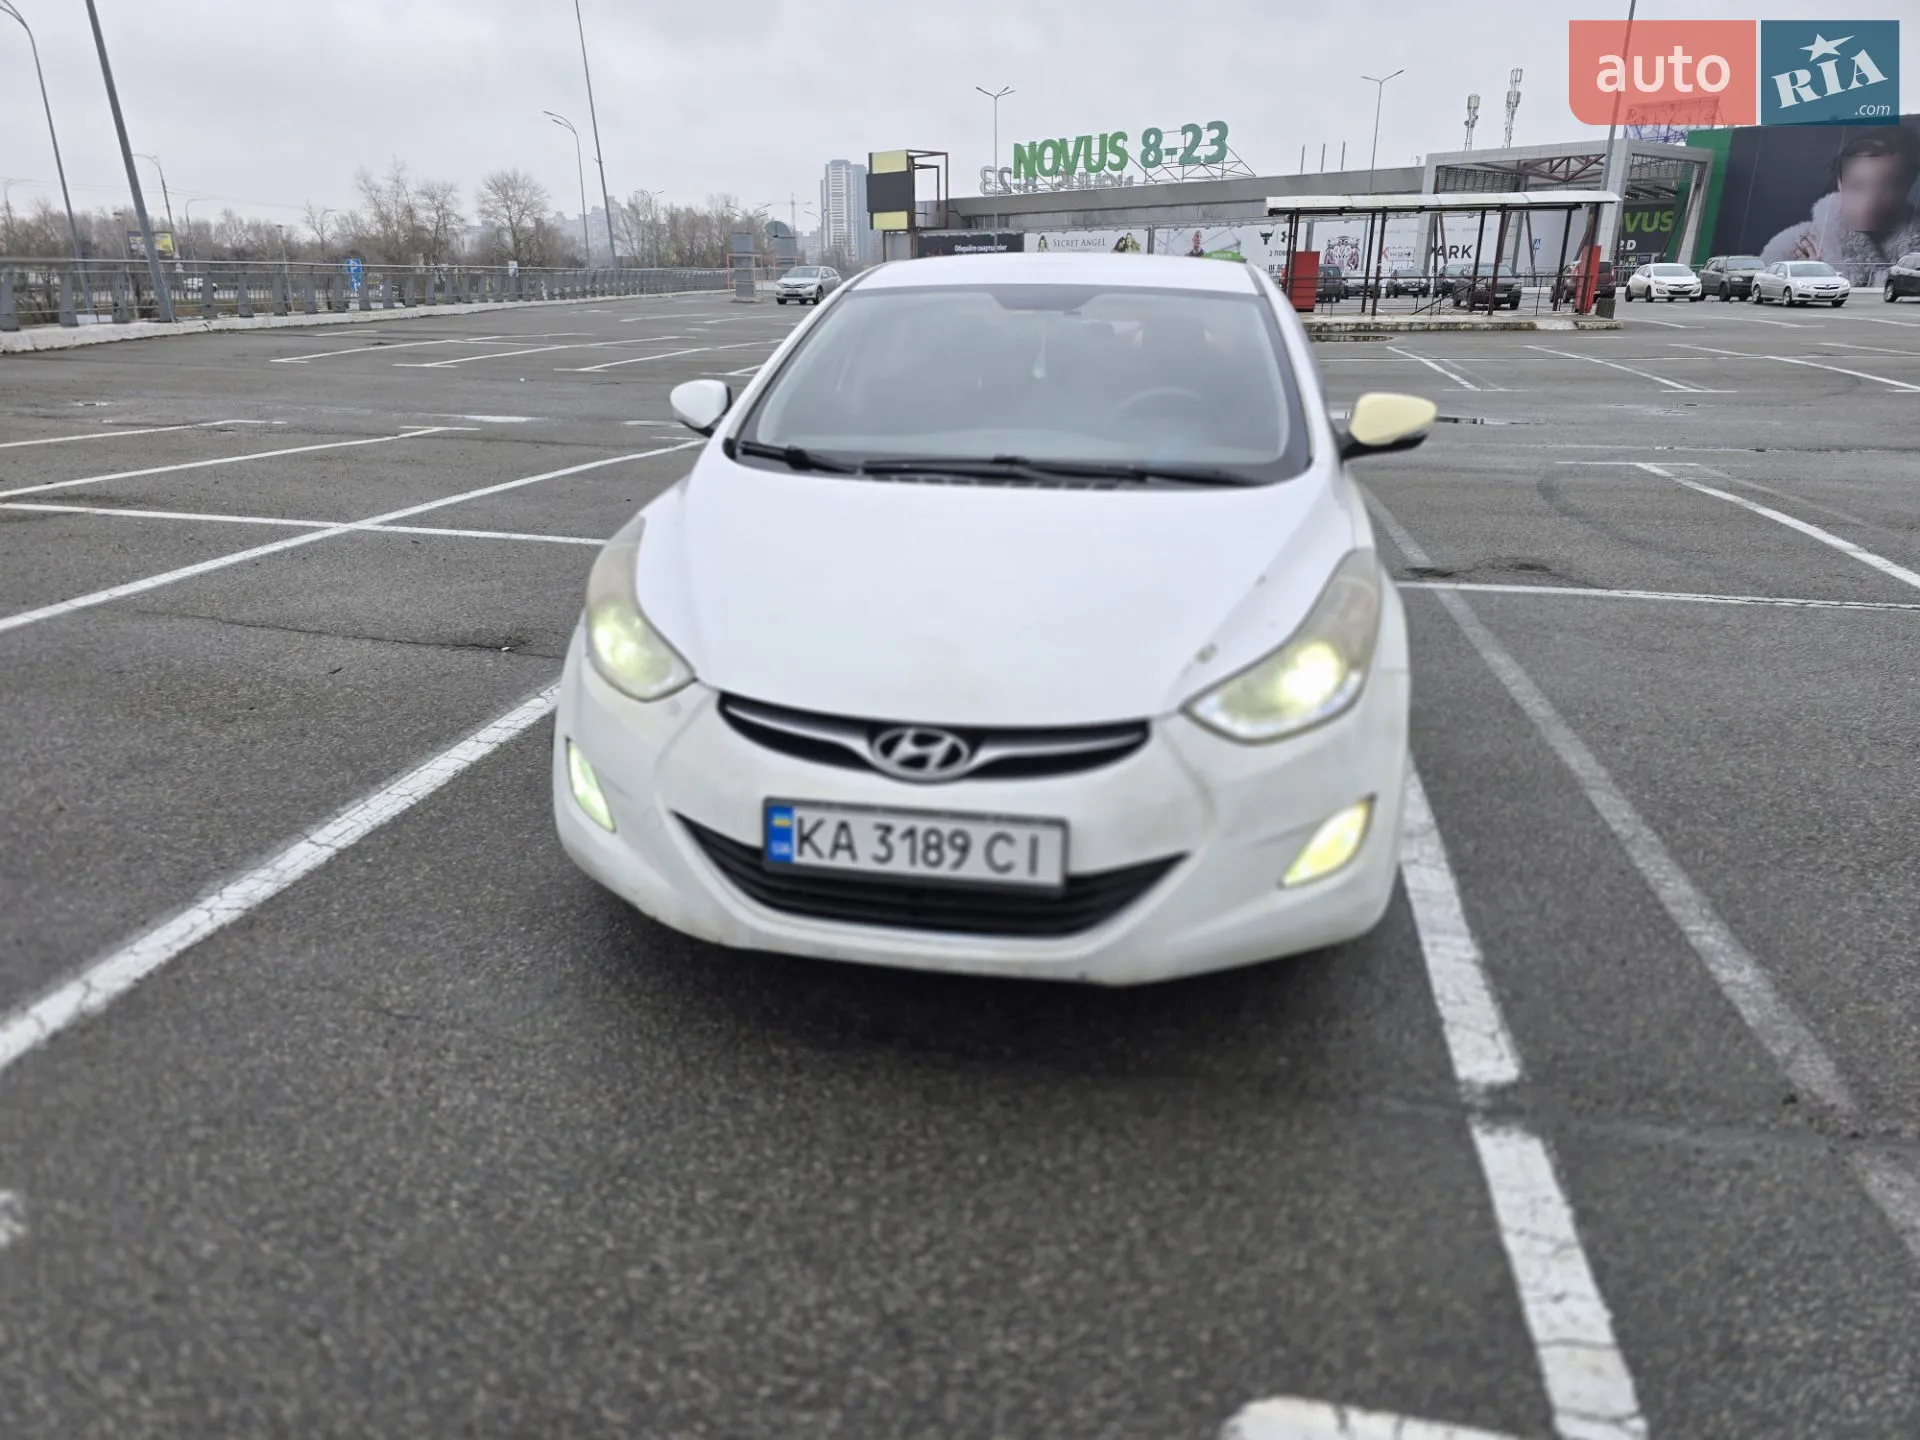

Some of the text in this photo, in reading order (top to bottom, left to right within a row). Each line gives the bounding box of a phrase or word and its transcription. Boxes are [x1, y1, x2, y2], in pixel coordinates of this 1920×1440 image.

[1014, 121, 1228, 179] NOVUS 8-23
[1053, 237, 1106, 248] SECRET ANGEL
[796, 816, 1039, 877] KA 3189 CI
